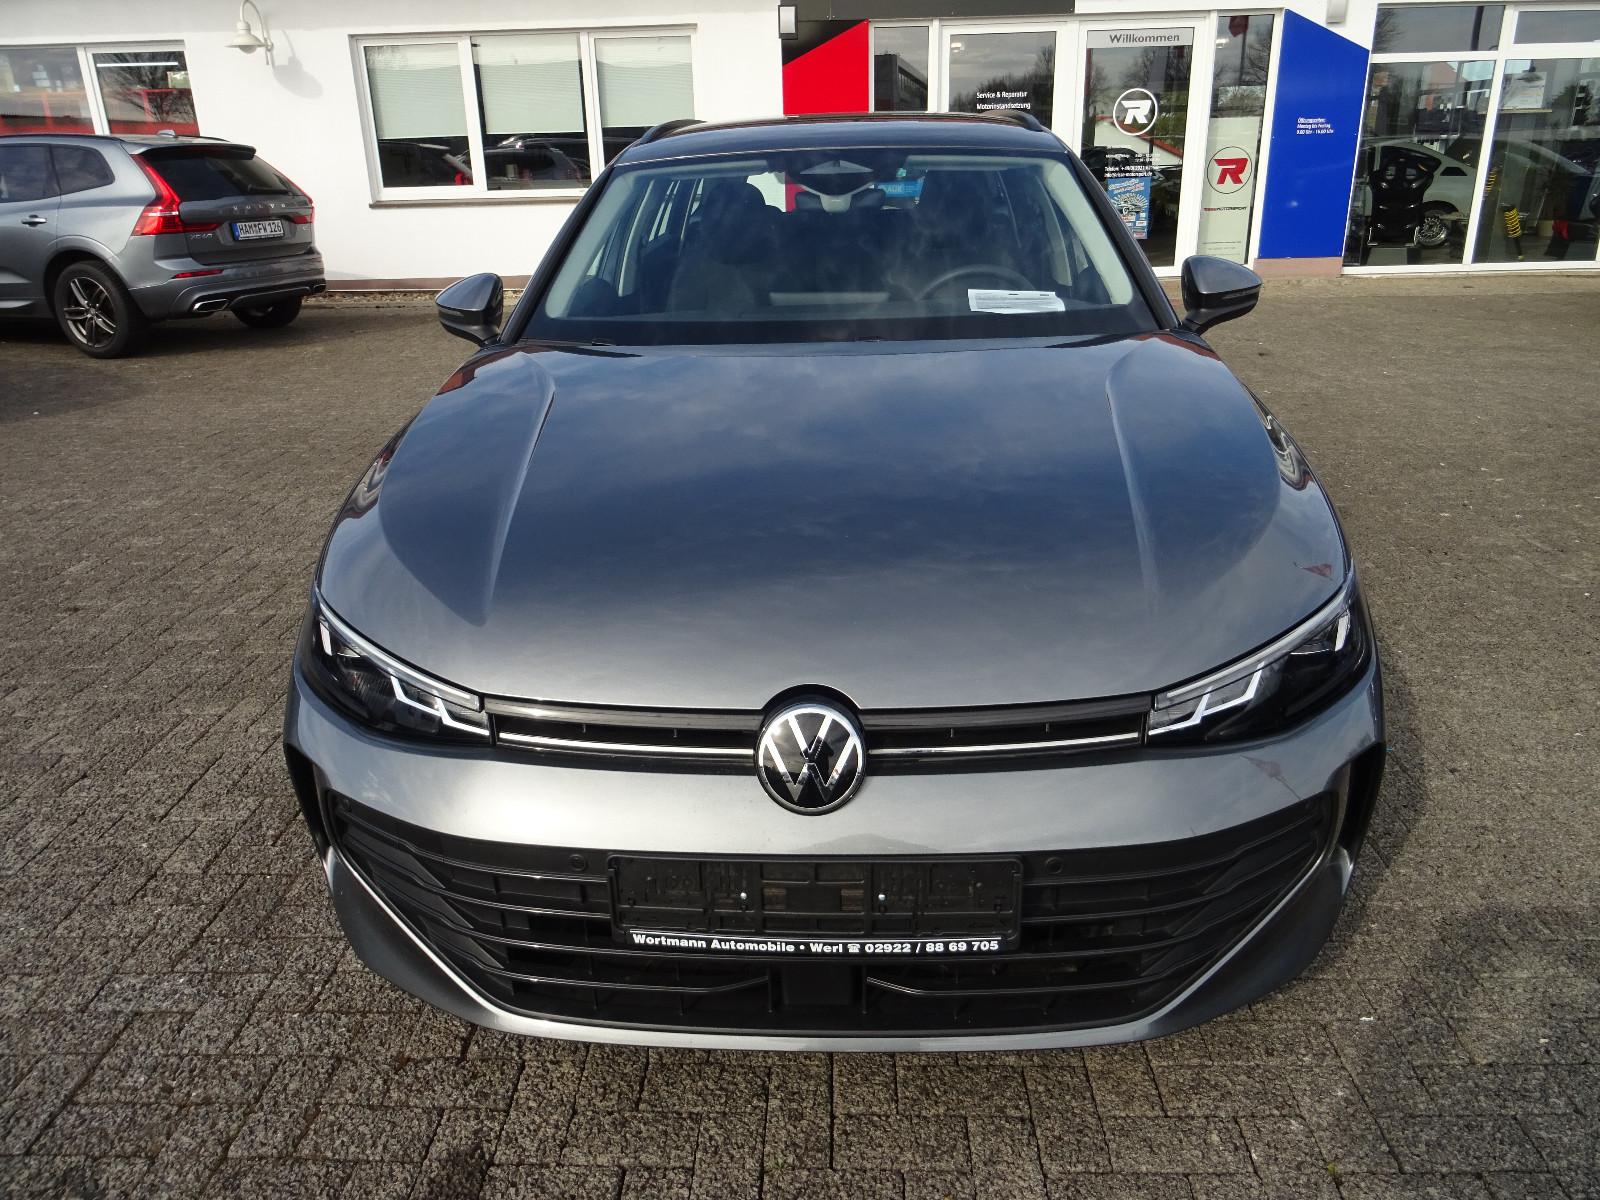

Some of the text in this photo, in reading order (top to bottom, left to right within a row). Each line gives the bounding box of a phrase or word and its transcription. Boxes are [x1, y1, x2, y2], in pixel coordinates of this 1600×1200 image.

[1109, 33, 1180, 43] Willkommen
[976, 91, 996, 99] Service
[1001, 91, 1028, 99] Reparatur
[976, 102, 1031, 110] Motorinstandsetzung
[1120, 99, 1152, 125] R
[1213, 157, 1249, 185] R
[632, 933, 999, 954] Wortmann Automobile Werl 02922 / 88 69 705
